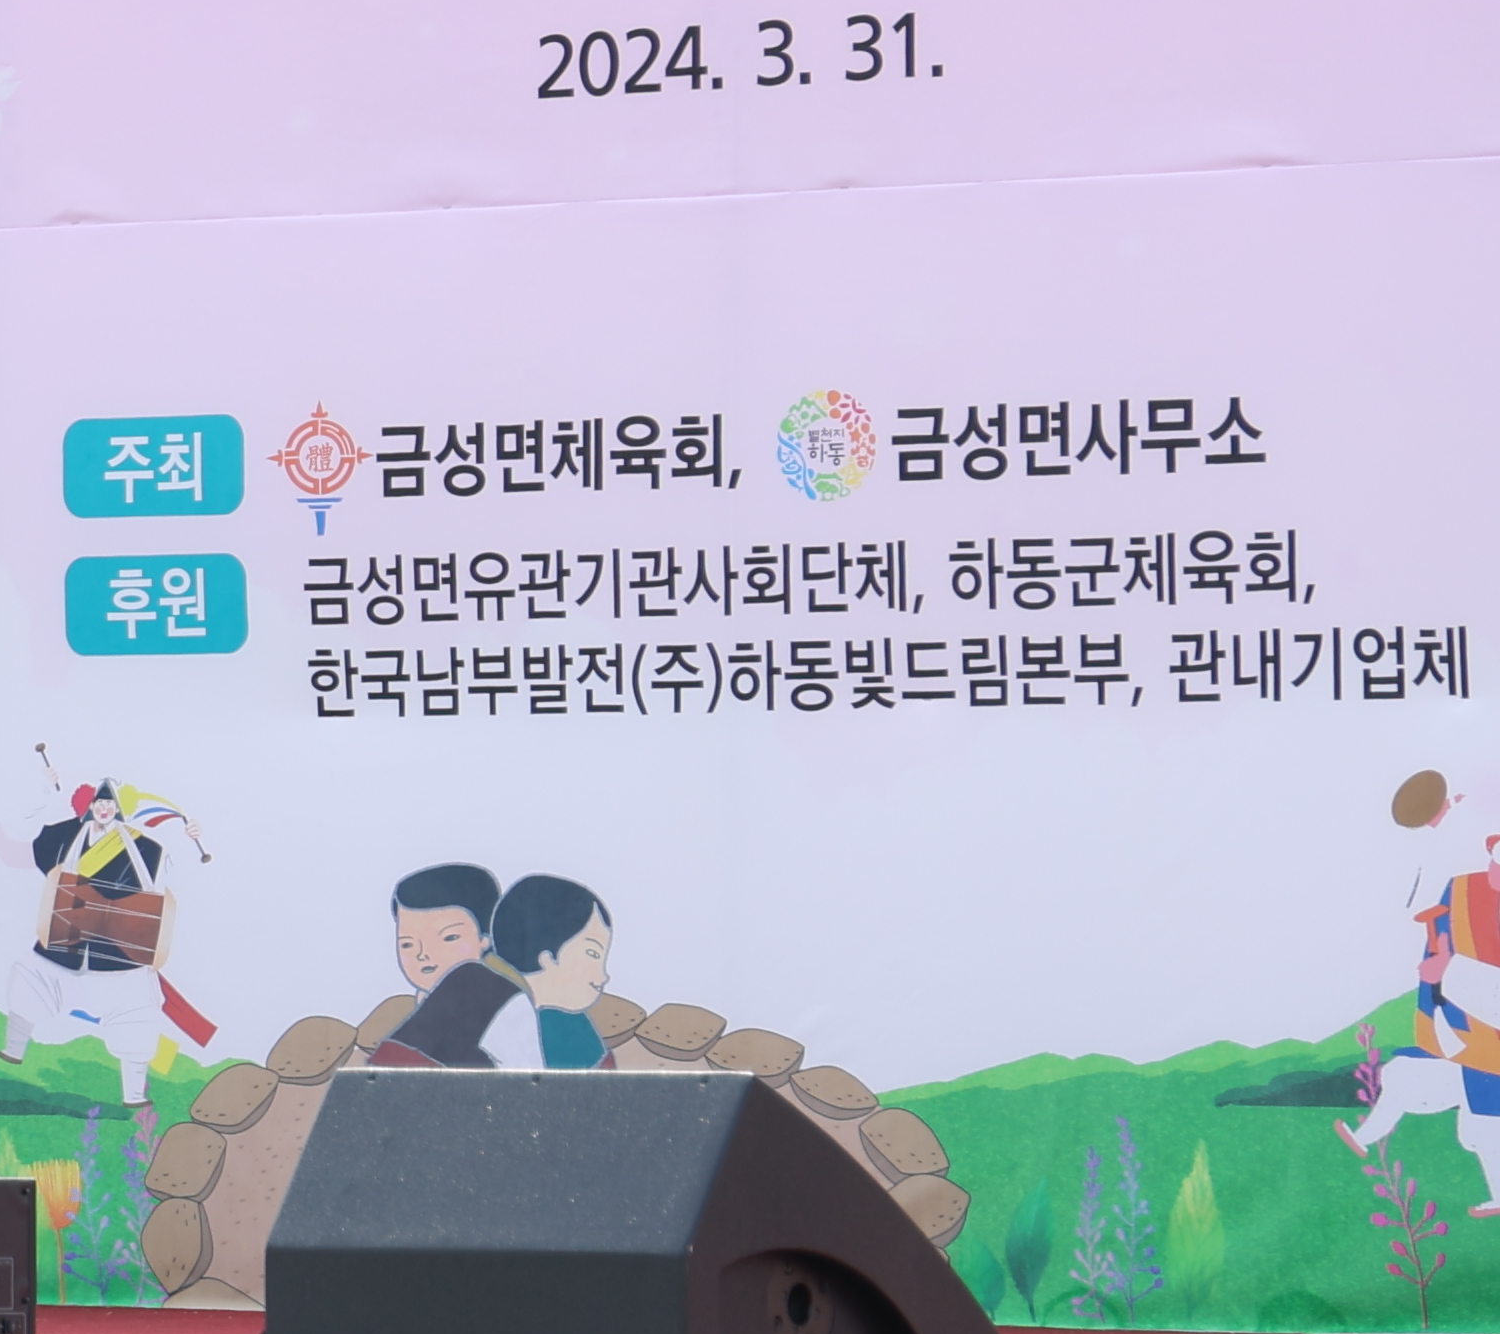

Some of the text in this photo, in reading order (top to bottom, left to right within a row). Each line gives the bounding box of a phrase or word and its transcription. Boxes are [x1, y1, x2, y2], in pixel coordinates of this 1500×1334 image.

[537, 12, 944, 100] 2024. 3. 31.
[103, 431, 203, 504] 주최
[375, 413, 743, 498] 금성면체육회,
[807, 427, 846, 443] 별천지
[807, 443, 846, 467] 하동
[890, 396, 1268, 482] 금성면사무소
[106, 566, 207, 640] 후원
[303, 528, 1316, 627] 금성면유관기관사회단체, 하동군체육회,
[307, 625, 1471, 720] 한국남부발전(주)하동빛드림본부, 관내기업체
